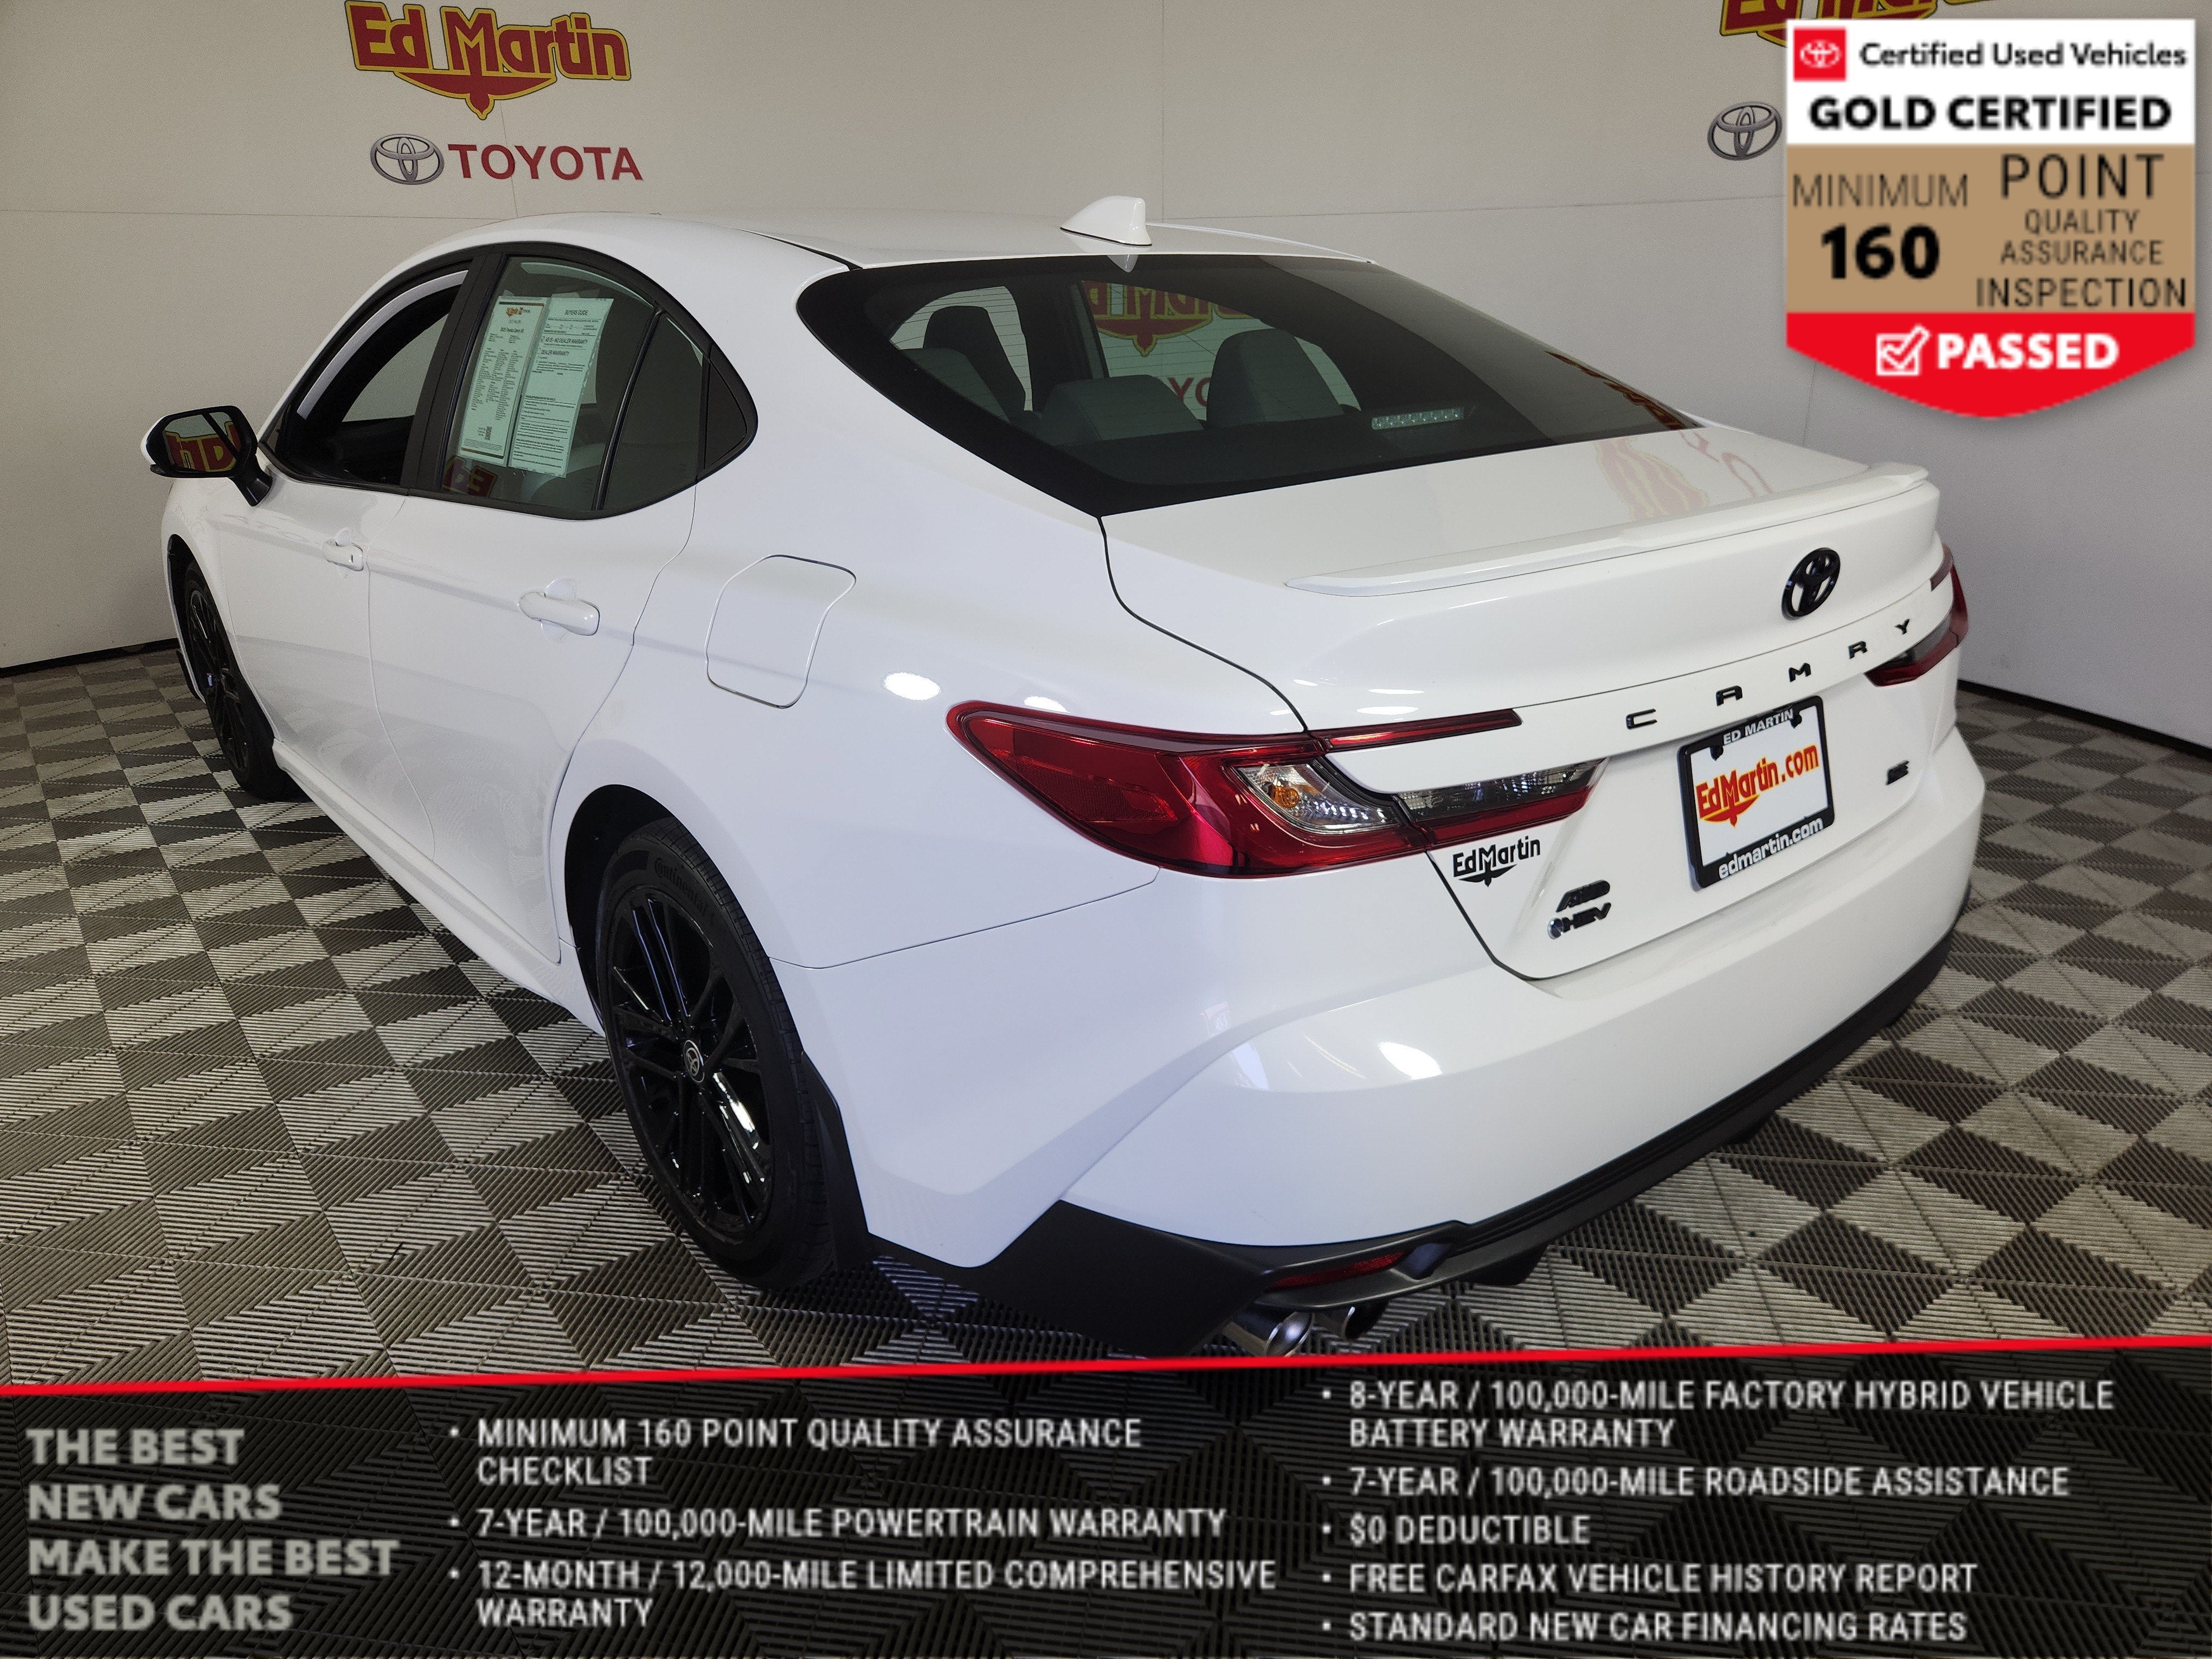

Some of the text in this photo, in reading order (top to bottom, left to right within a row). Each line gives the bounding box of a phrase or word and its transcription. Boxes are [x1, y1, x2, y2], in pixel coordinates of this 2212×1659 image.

[346, 1, 631, 81] Ed Martin
[448, 144, 644, 180] TOYOTA
[1626, 619, 1910, 730] CAMRY
[1723, 709, 1795, 746] ED MARTIN
[1695, 744, 1820, 827] EdMartin.com
[1452, 835, 1541, 888] EdMartin
[1719, 818, 1824, 879] edmartin.com
